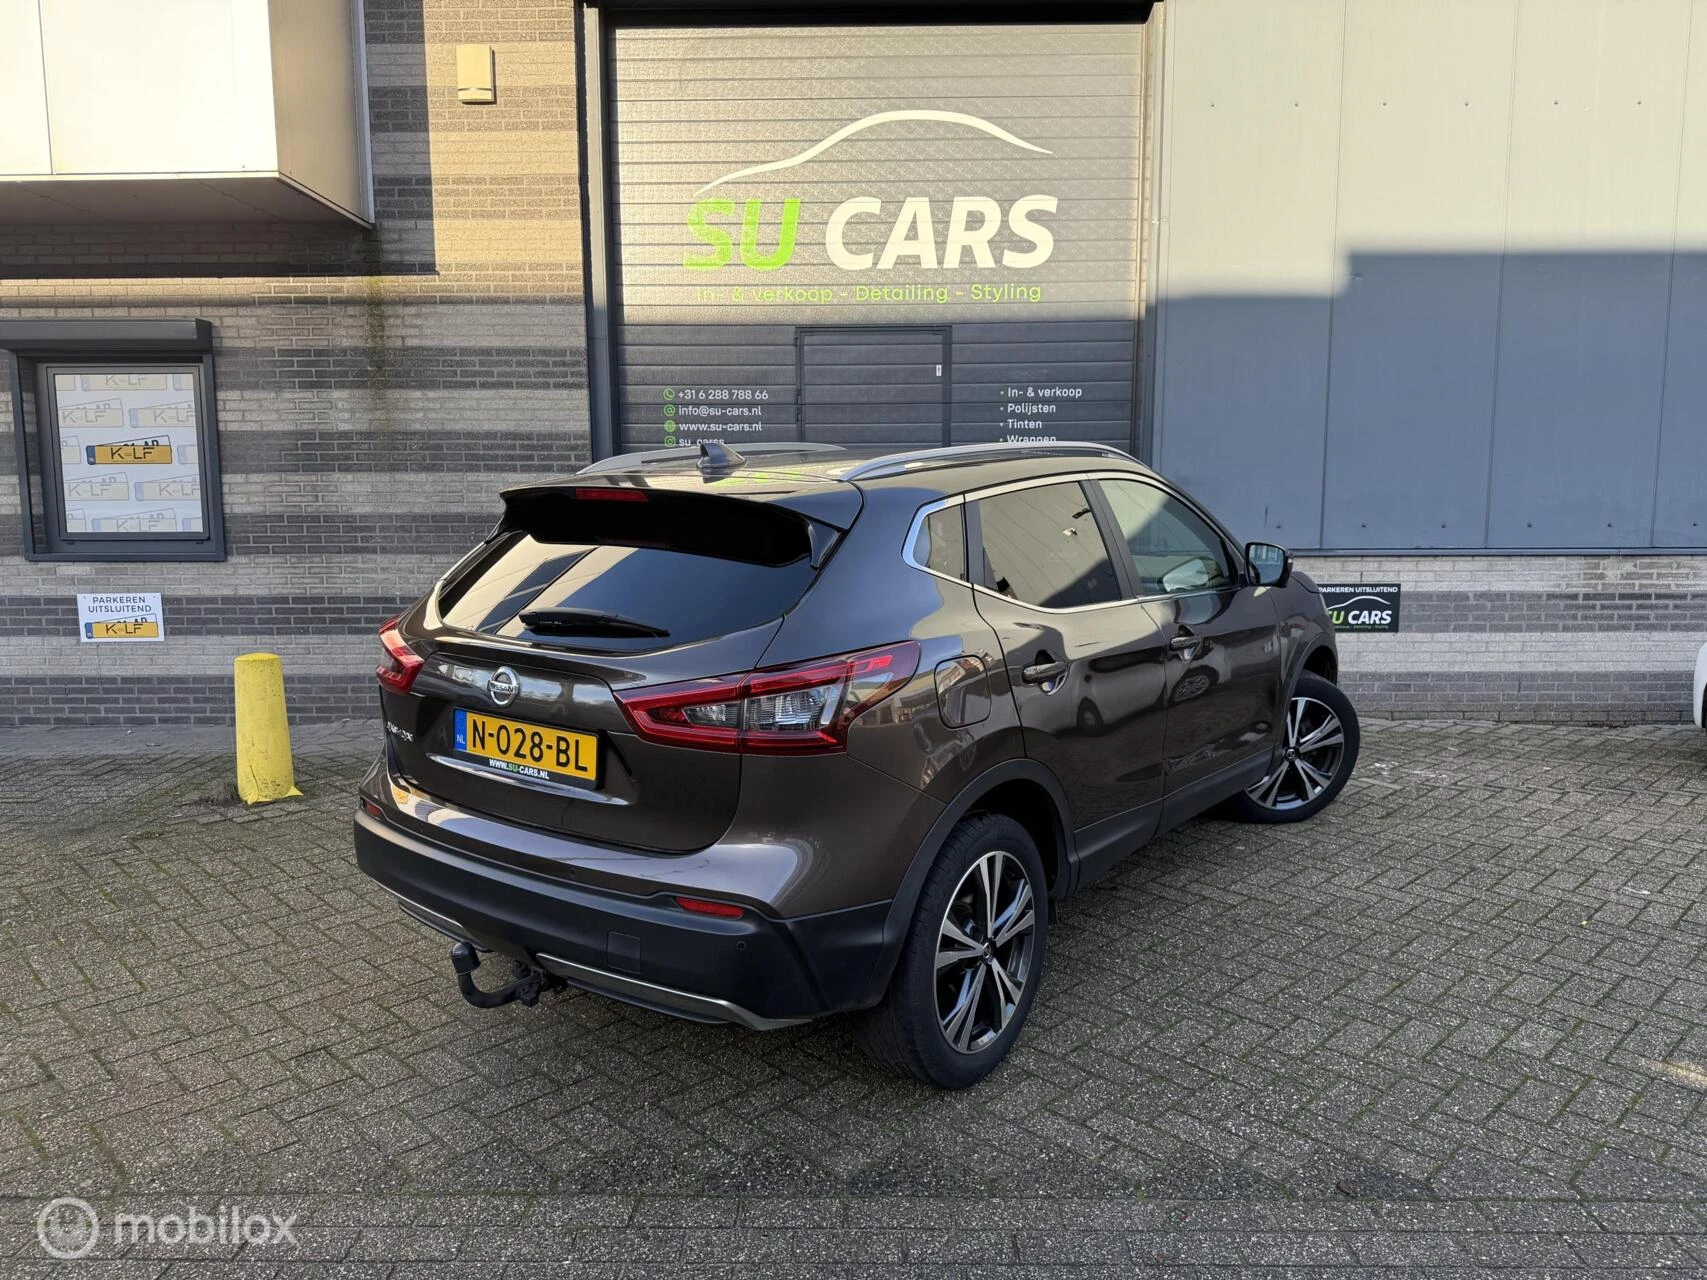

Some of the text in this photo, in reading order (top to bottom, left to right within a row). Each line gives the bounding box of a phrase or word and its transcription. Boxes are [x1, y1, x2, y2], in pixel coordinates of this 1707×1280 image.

[683, 195, 1059, 271] SU CARS
[697, 287, 724, 301] In-
[732, 287, 744, 301] &
[753, 285, 833, 304] verkoop
[855, 285, 949, 303] Detailing
[971, 283, 1041, 303] Styling
[678, 390, 769, 400] +31 6 288 788 66
[1007, 386, 1083, 399] In- & verkoop
[678, 405, 762, 417] info@su-cars.nl
[1007, 402, 1056, 415] Polijsten
[679, 421, 762, 431] www.su-cars.nl
[1007, 419, 1042, 429] Tinten
[92, 596, 146, 604] PARKEREN
[88, 605, 152, 613] UITSLUITEND
[1347, 610, 1392, 624] CARS
[456, 718, 588, 772] NL N-028-BL
[489, 758, 550, 780] WWW.SU-CARS.NL
